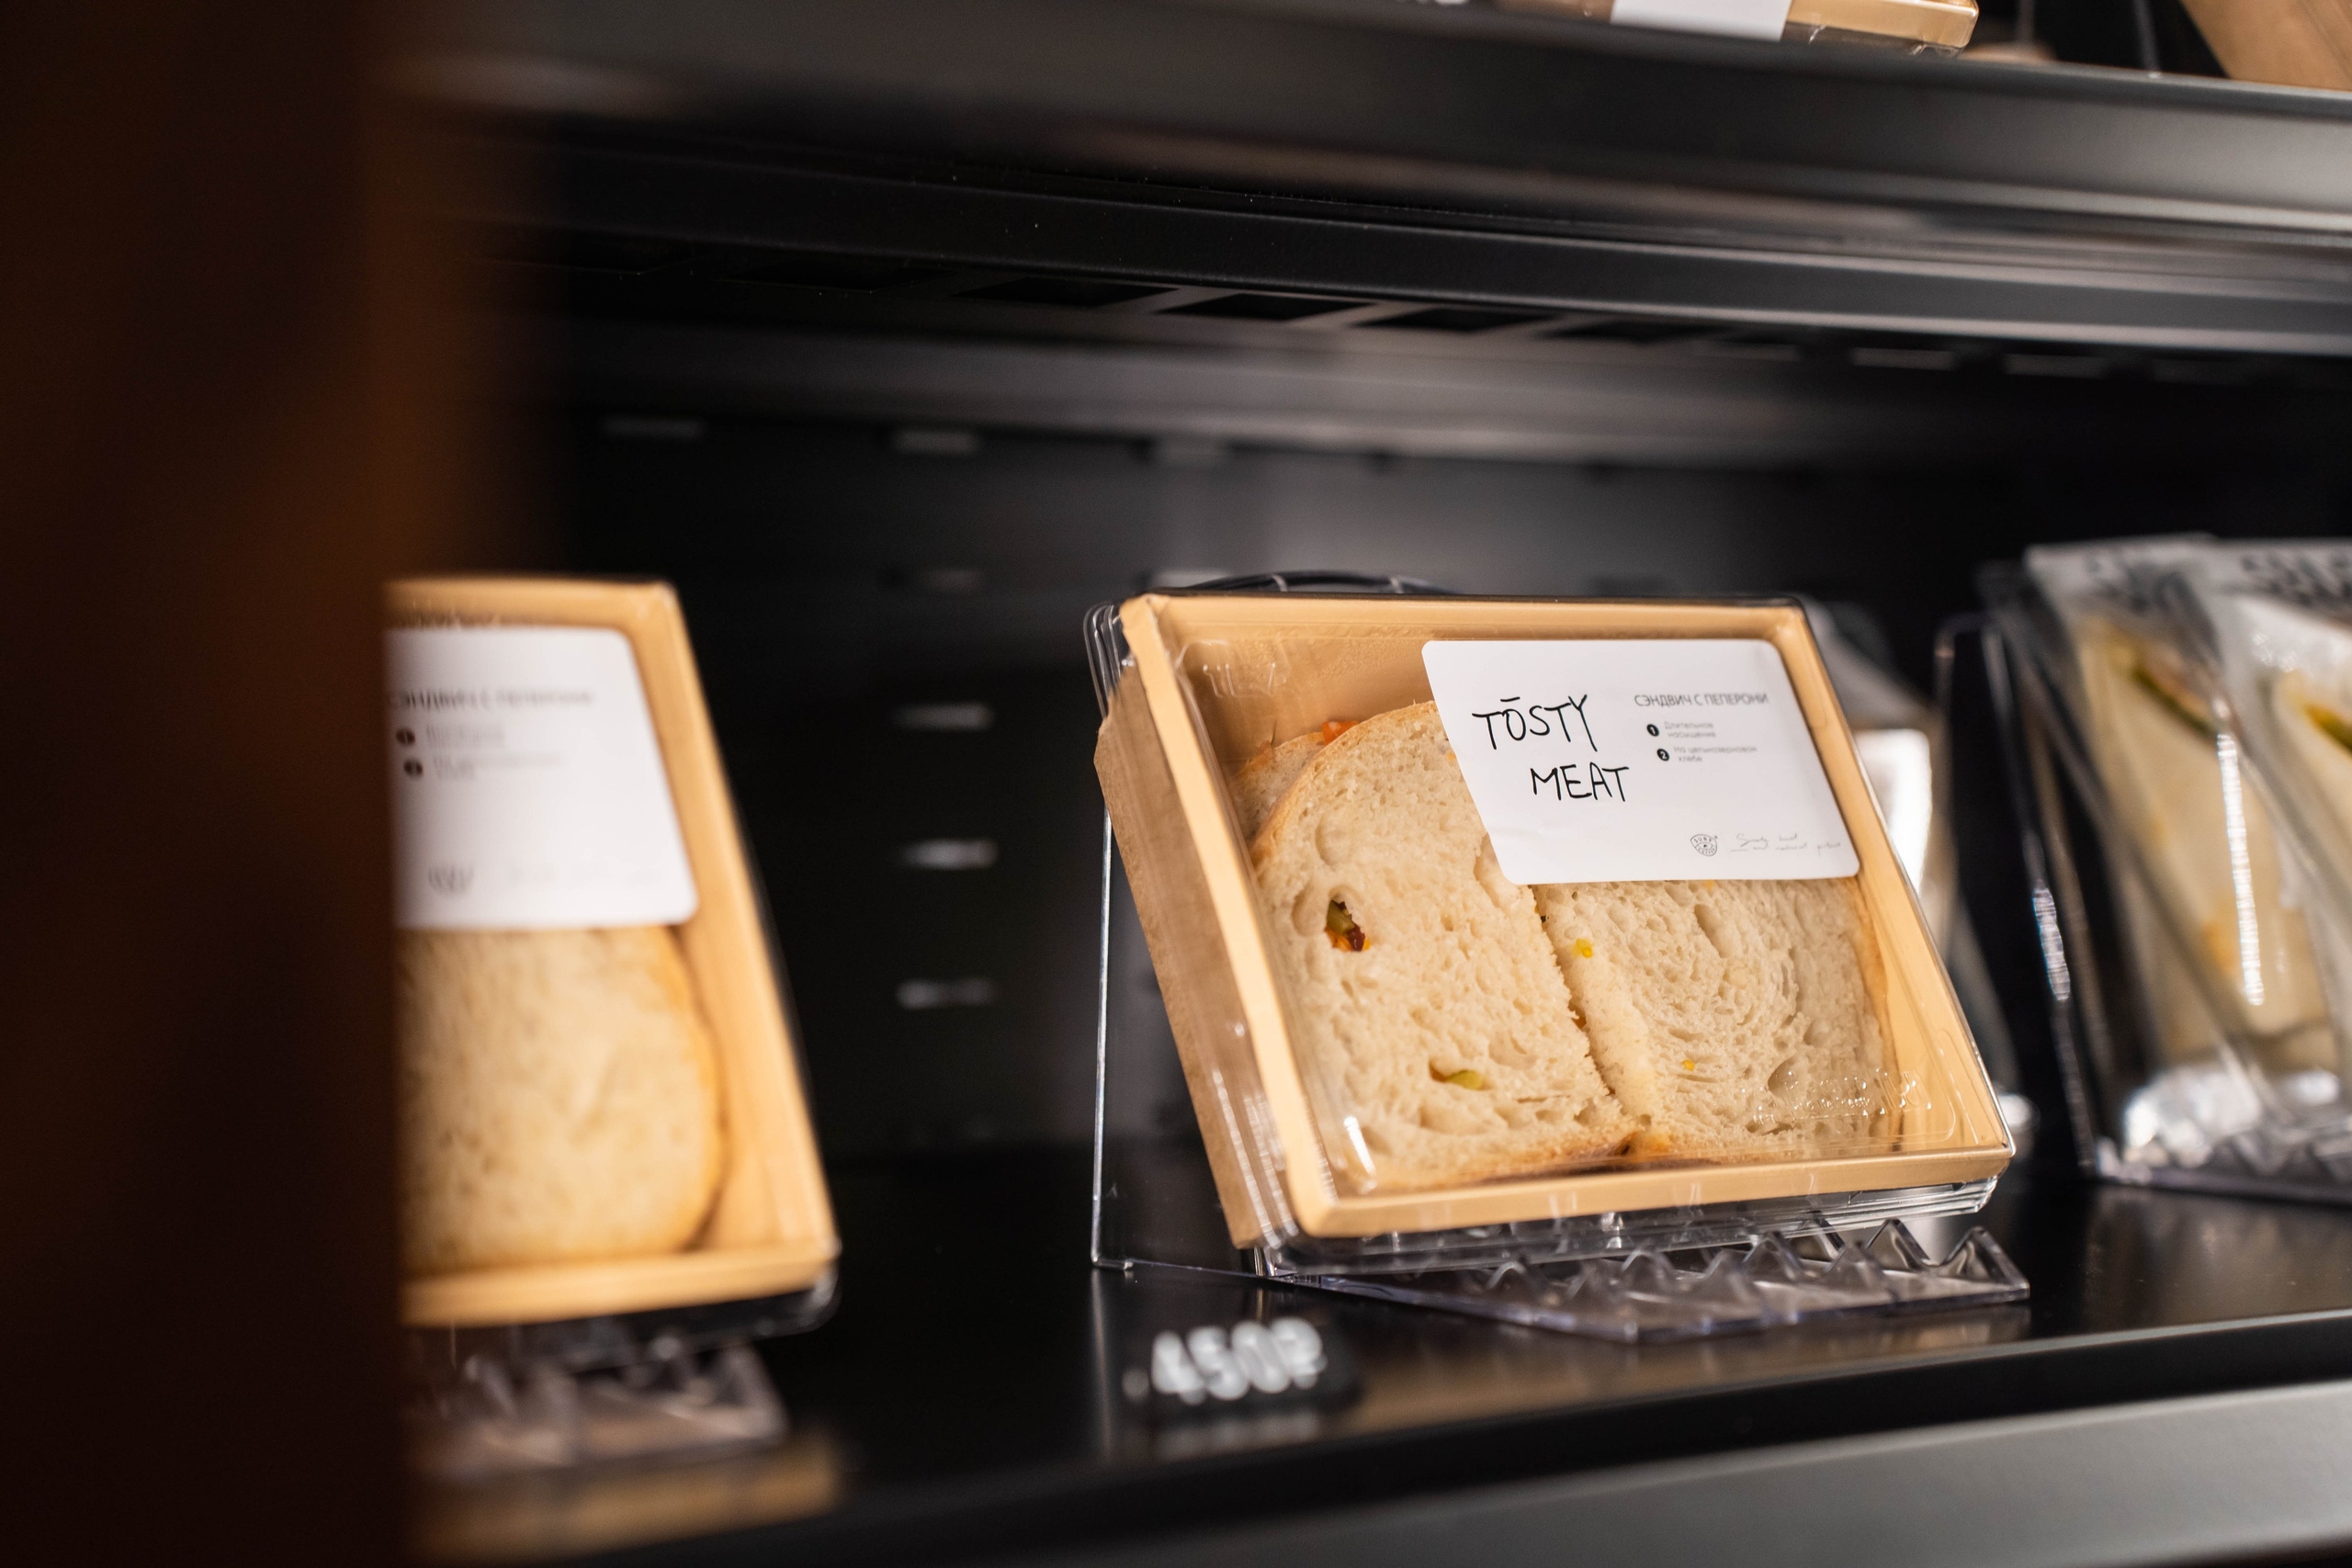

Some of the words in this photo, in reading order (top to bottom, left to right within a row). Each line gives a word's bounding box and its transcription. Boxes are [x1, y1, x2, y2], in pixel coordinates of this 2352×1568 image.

[1634, 694, 1692, 707] СЭНДВИЧ
[1694, 694, 1703, 706] С
[1704, 693, 1770, 706] ПЕПЕРОНИ
[1530, 761, 1630, 802] MEAT
